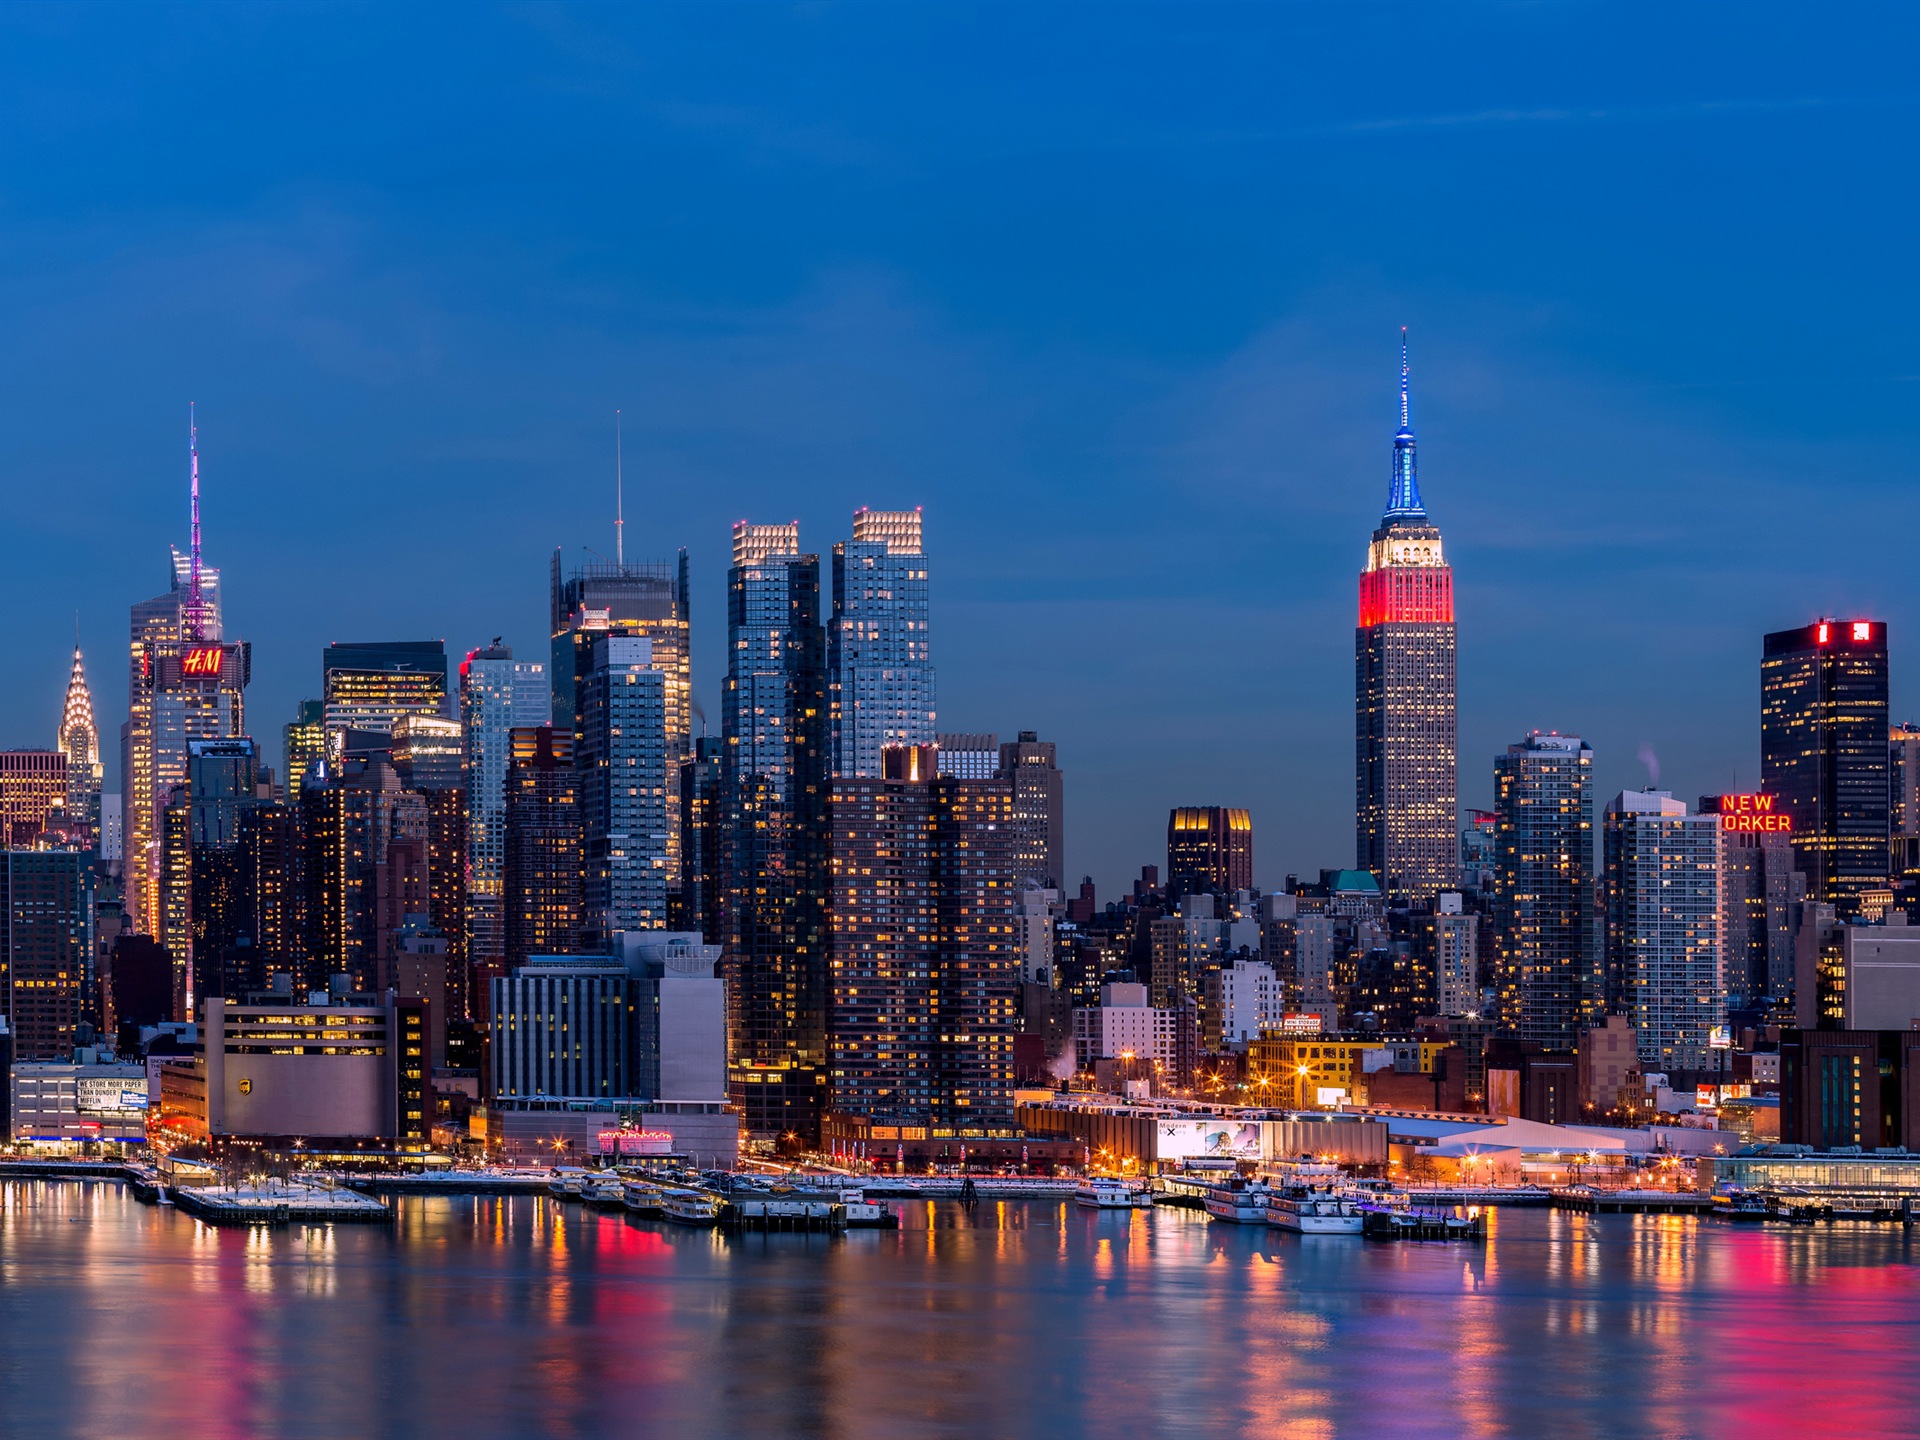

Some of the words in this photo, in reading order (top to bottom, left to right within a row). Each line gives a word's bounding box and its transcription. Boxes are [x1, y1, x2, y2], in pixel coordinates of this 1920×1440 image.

[184, 649, 221, 673] H&M
[1723, 795, 1772, 811] NEW
[1720, 815, 1791, 831] ORKER
[80, 1080, 88, 1088] WE
[89, 1080, 106, 1088] STORE
[107, 1080, 123, 1088] MORE
[124, 1080, 142, 1088] PAPER
